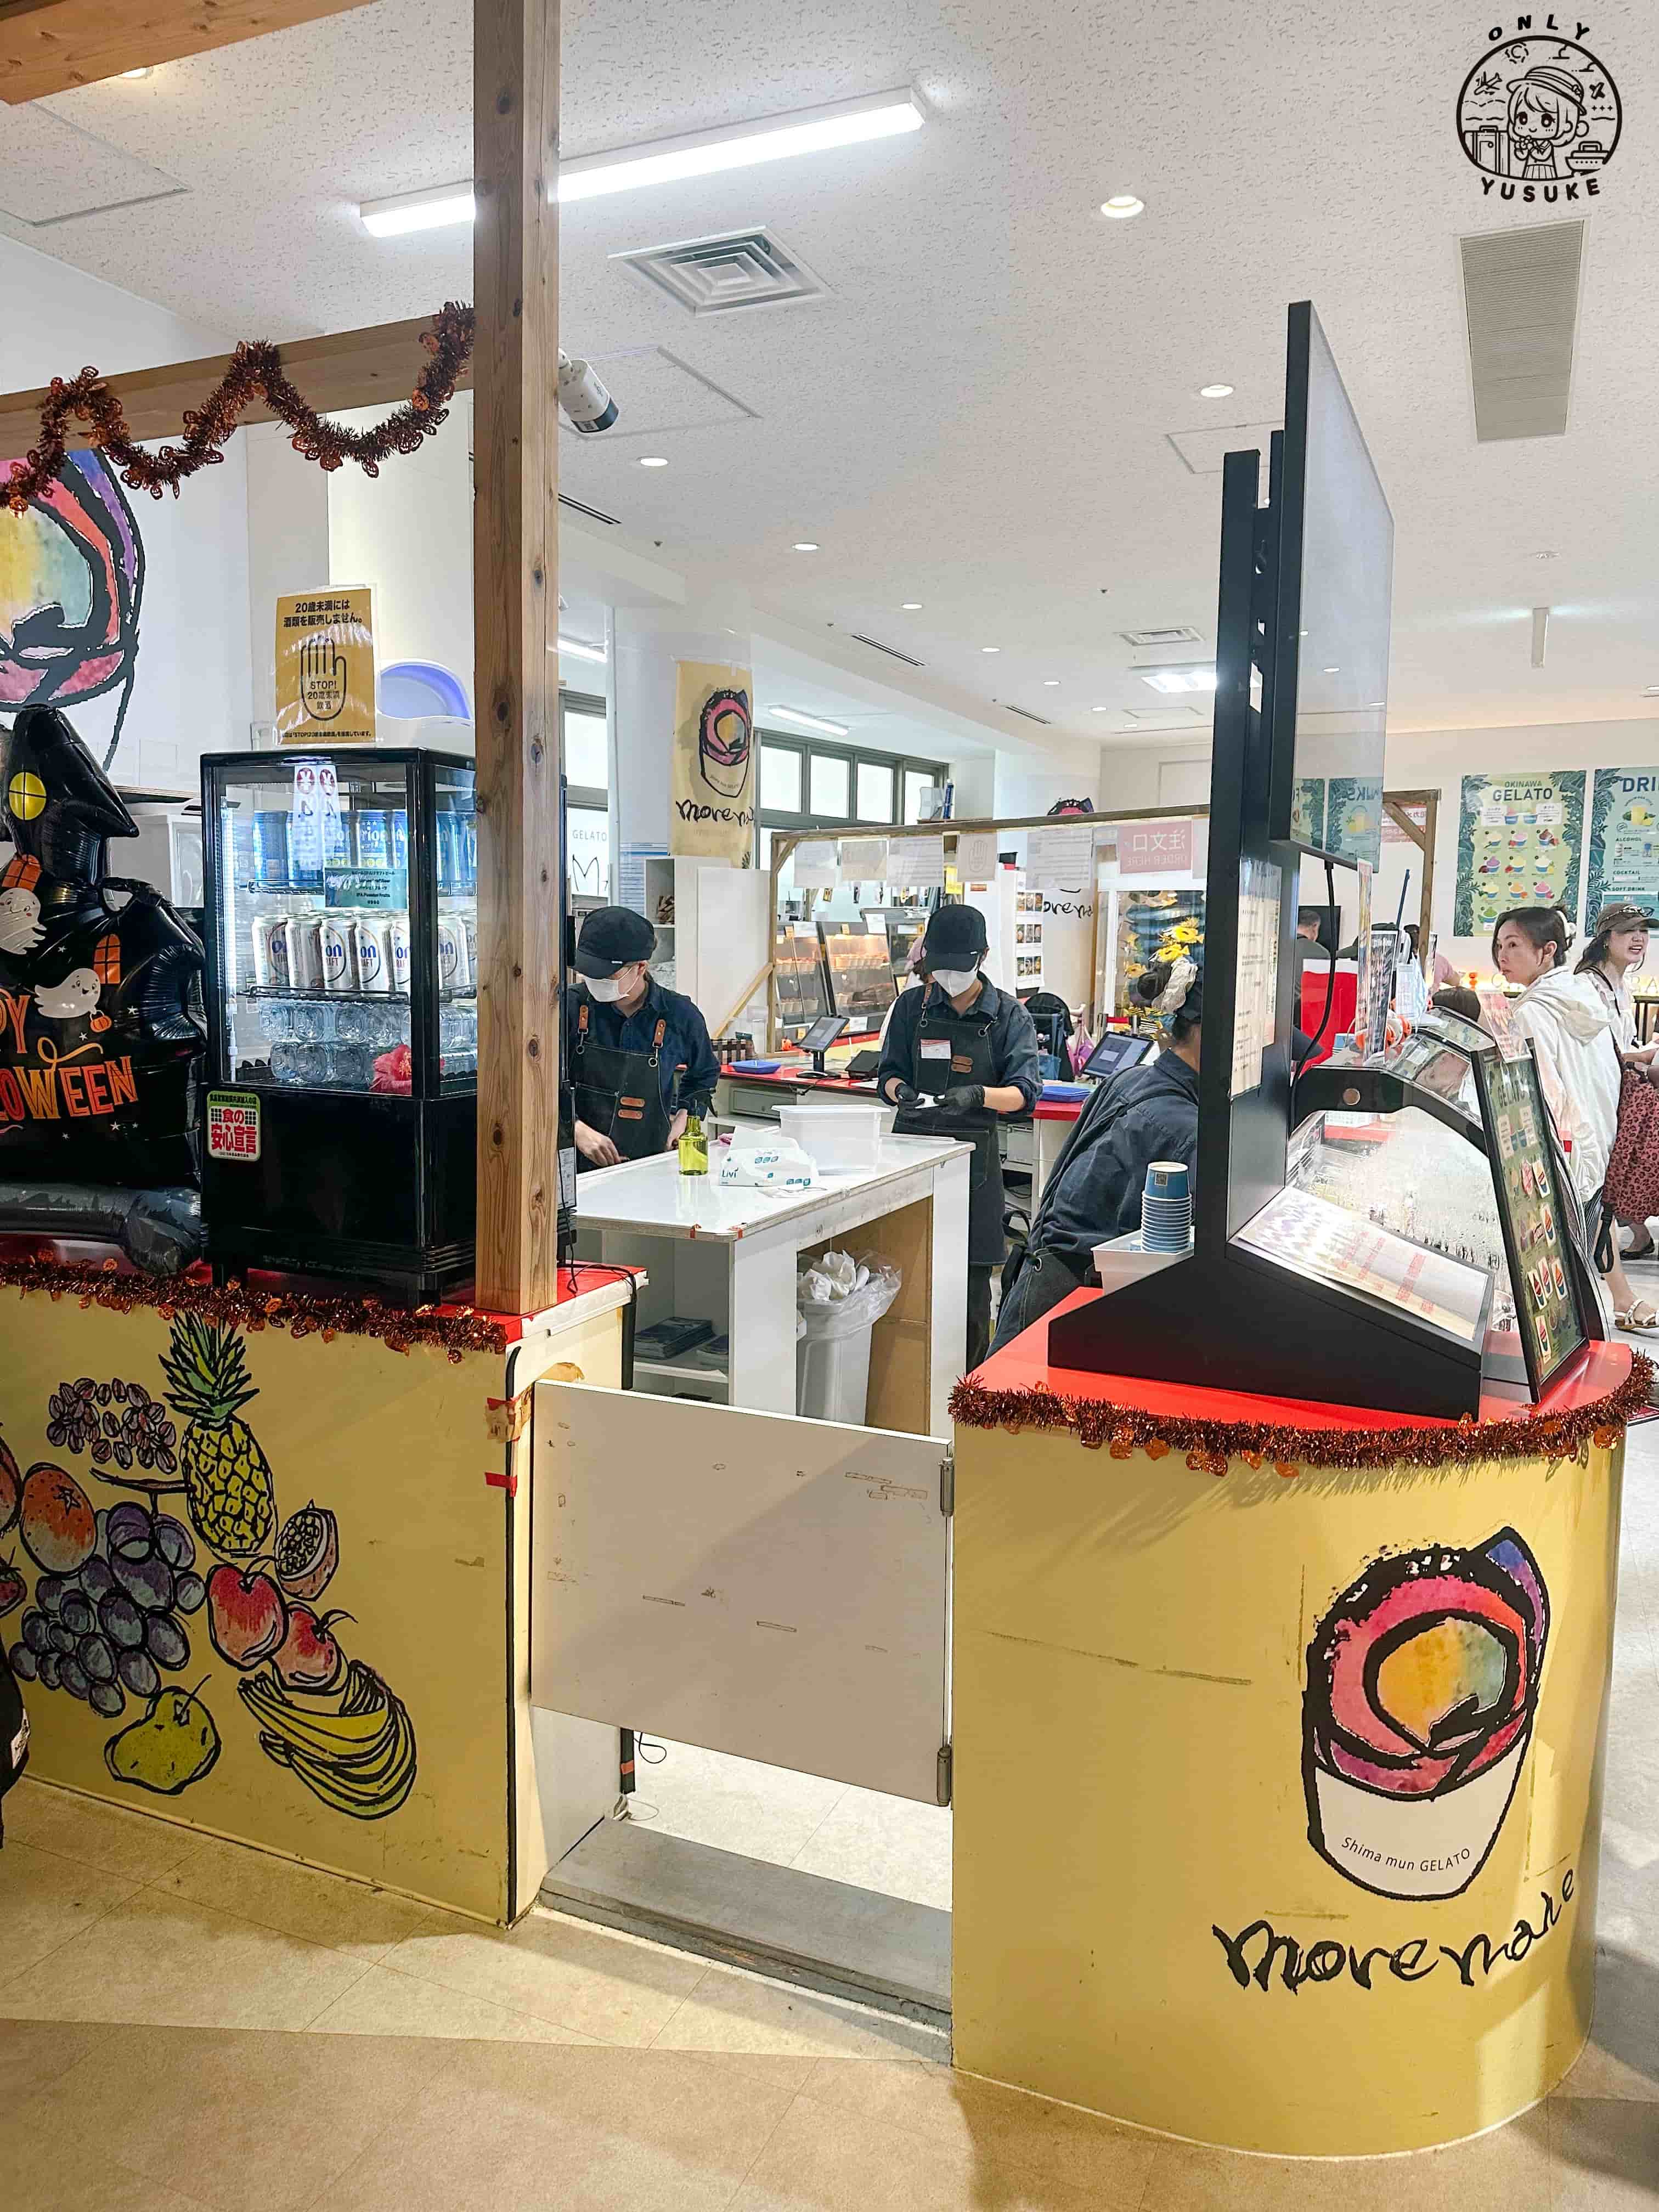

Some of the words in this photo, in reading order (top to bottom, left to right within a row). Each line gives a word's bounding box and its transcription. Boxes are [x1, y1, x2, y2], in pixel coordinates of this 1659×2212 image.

[295, 599, 350, 613] 20歳未満には
[284, 612, 363, 628] 酒類を販売しません。
[311, 680, 336, 690] STOP!
[1622, 776, 1659, 792] DRI
[1493, 788, 1553, 802] GELATO
[572, 830, 607, 842] GELATO
[0, 1056, 138, 1121] OWEEN
[222, 1109, 245, 1124] 食の
[211, 1124, 257, 1154] 安心宣言
[721, 1167, 738, 1178] Livi
[1341, 1837, 1382, 1863] Shima
[1386, 1857, 1414, 1870] mun
[1420, 1848, 1470, 1872] GELATO
